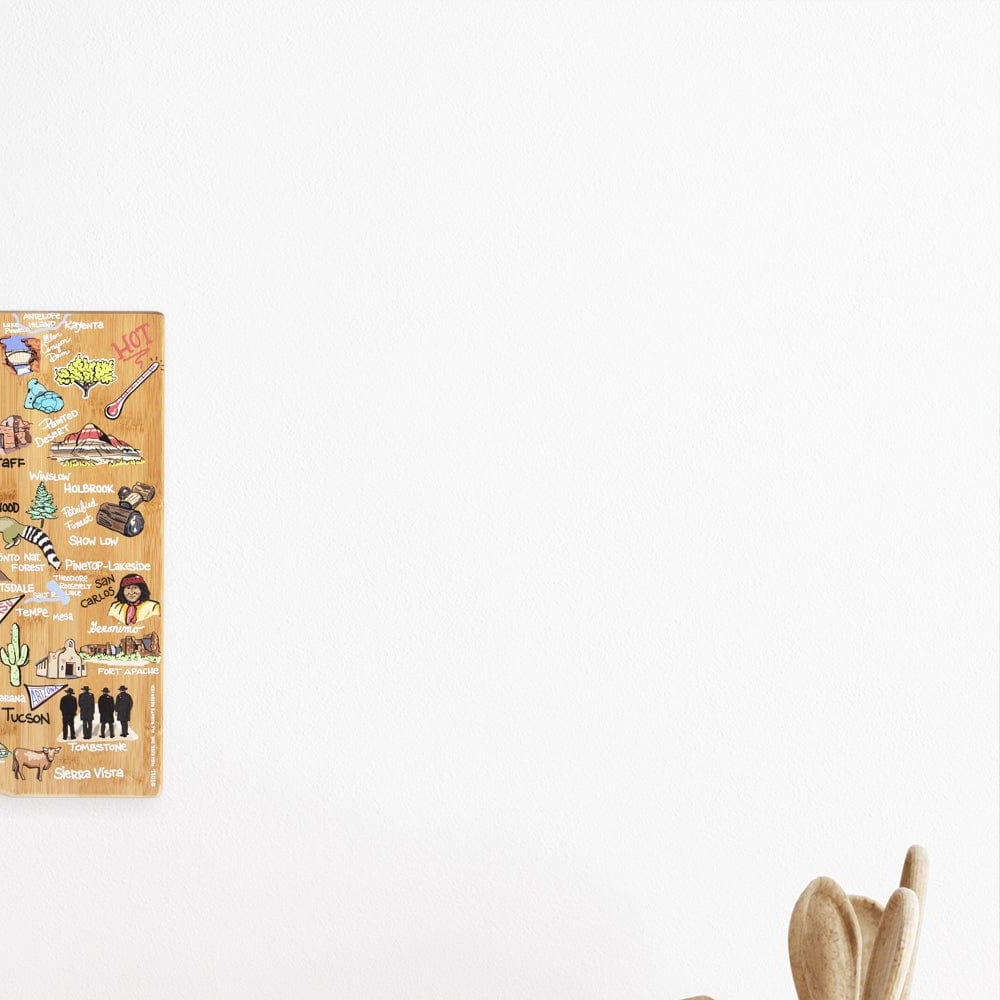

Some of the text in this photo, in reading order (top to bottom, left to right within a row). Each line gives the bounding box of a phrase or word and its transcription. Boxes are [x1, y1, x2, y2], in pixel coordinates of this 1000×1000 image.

[41, 337, 72, 354] Canyon
[111, 322, 153, 360] HOT
[46, 349, 70, 362] Dam
[64, 483, 115, 494] HOLBROOK
[64, 513, 94, 530] Forest
[68, 536, 119, 546] SHOW LOW
[88, 620, 145, 634] Geronimo
[97, 668, 121, 676] FORT
